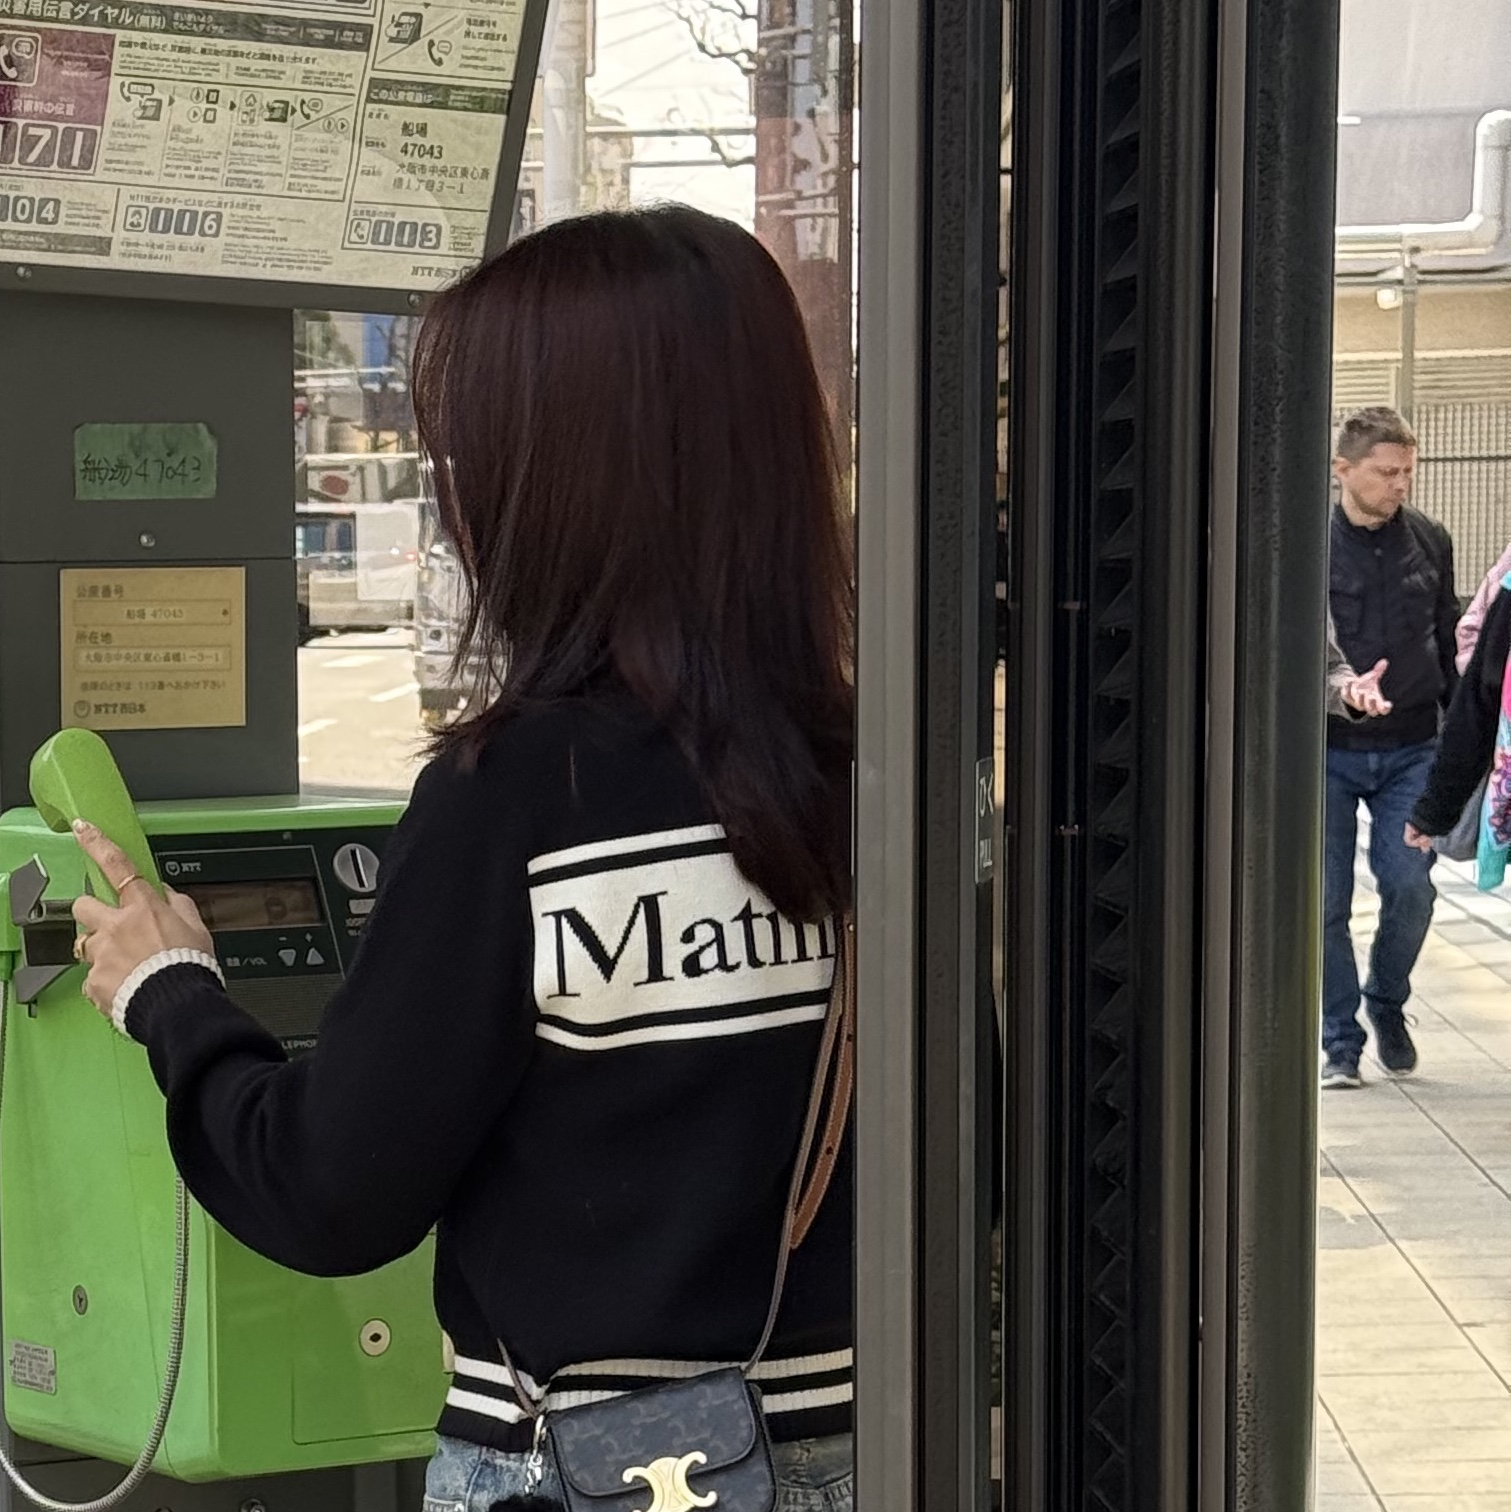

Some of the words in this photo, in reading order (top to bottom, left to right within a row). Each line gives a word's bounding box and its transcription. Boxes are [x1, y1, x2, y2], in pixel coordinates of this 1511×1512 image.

[399, 142, 444, 159] 47043
[156, 209, 218, 235] 116
[378, 220, 437, 247] 113
[150, 607, 184, 620] 47043
[75, 630, 113, 645] 所在地
